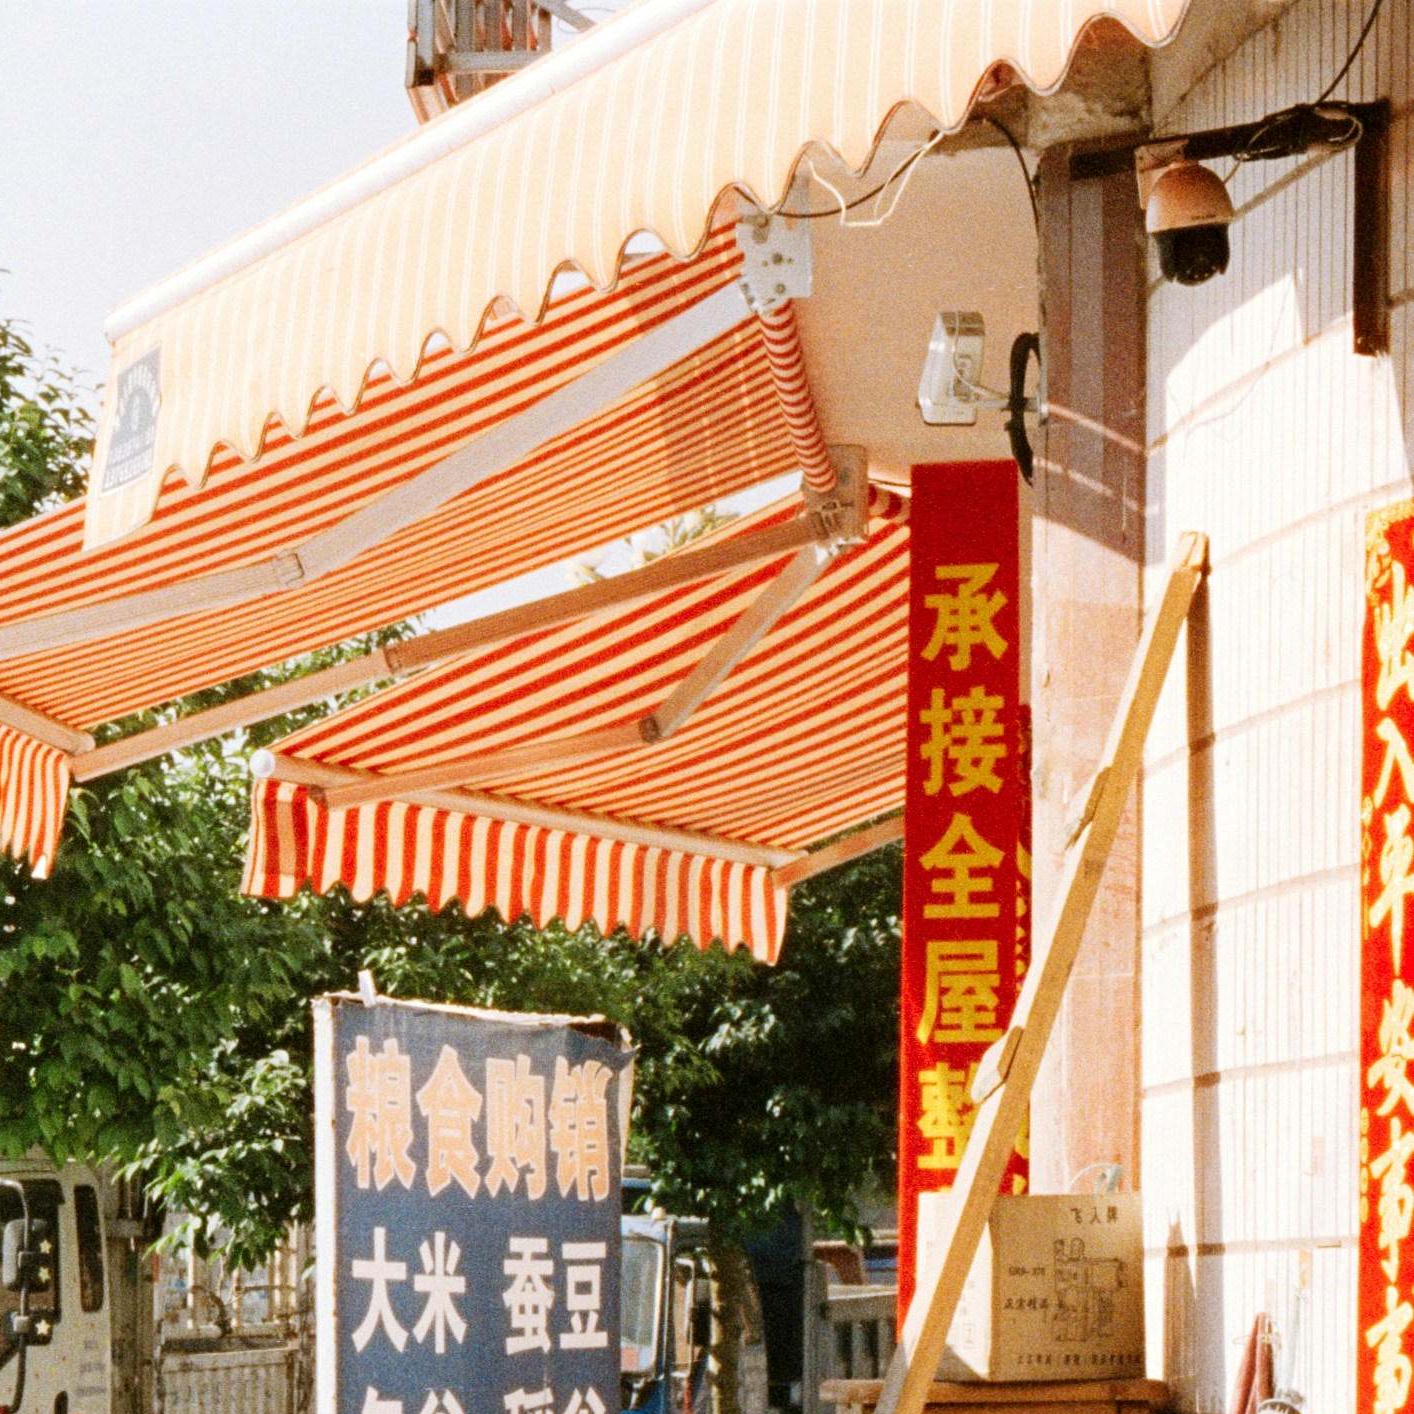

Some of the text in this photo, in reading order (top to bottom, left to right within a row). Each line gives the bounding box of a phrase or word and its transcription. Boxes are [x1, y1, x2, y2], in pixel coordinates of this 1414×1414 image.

[345, 1035, 613, 1201] 粮食购销
[351, 1227, 609, 1356] 大米 蚕豆
